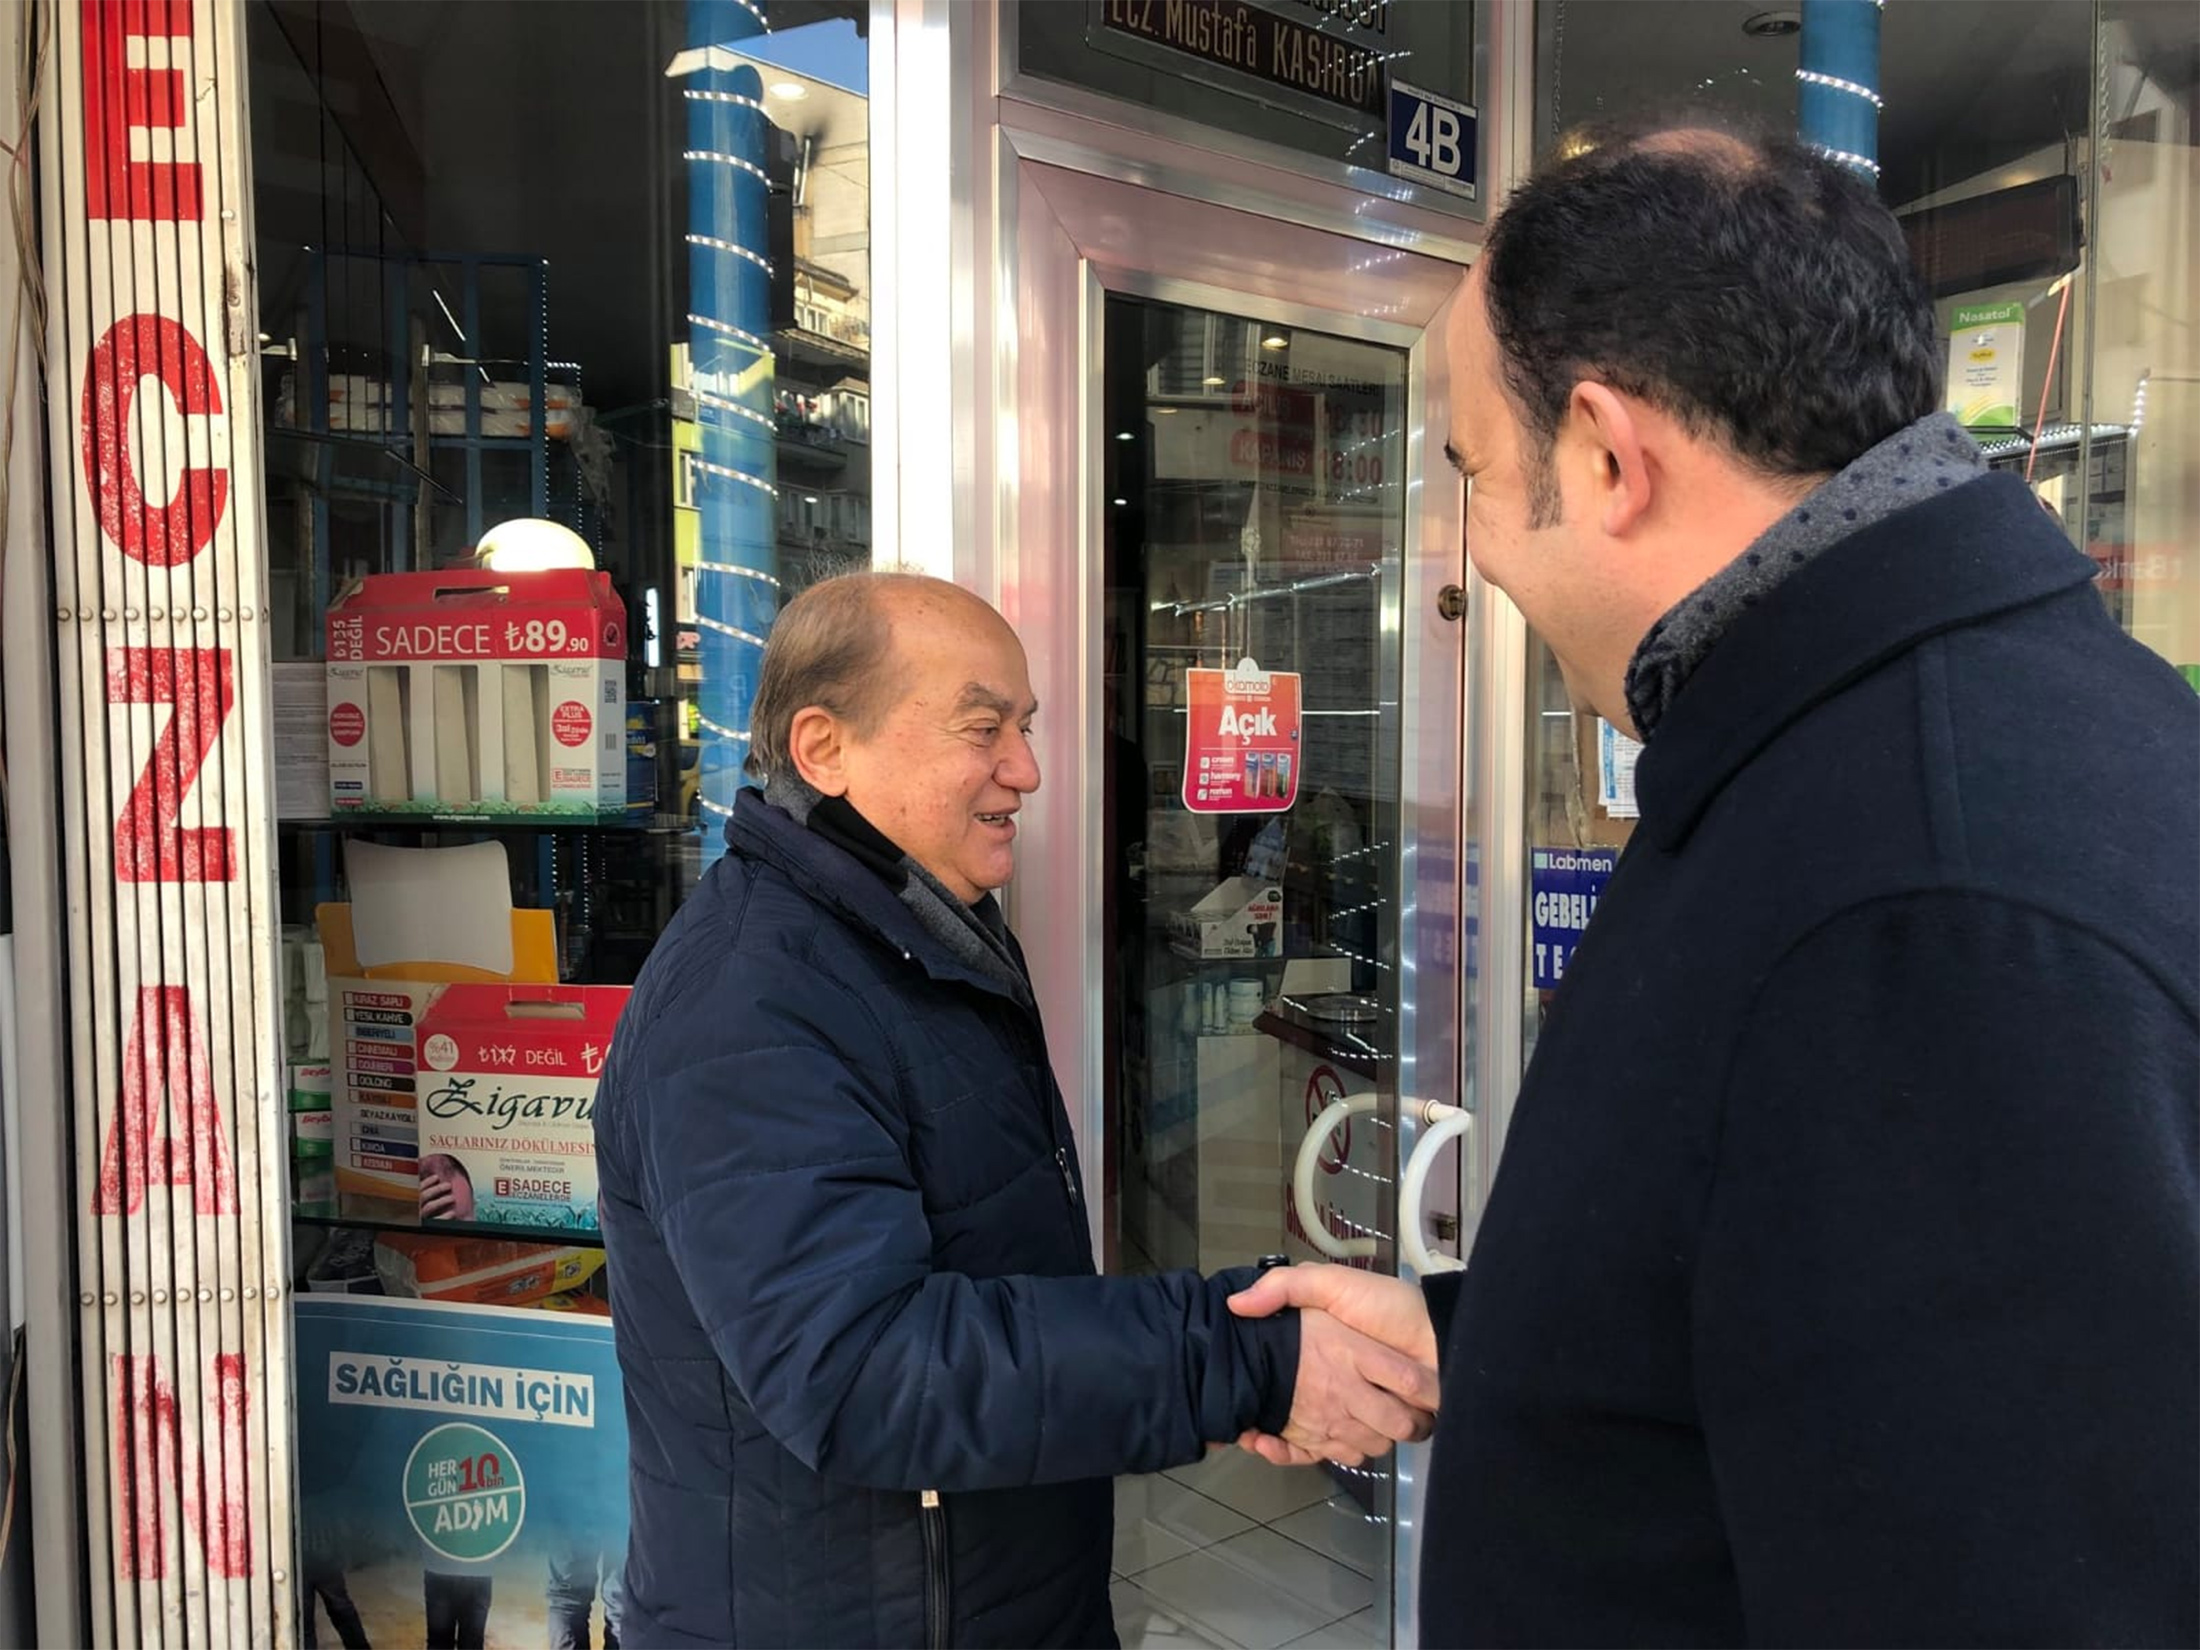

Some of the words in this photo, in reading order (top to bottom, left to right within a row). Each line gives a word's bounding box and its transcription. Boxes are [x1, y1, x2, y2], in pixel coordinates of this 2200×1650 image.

[1166, 0, 1257, 68] Mustafa
[1405, 101, 1461, 176] 4B
[376, 624, 491, 656] SADECE
[1218, 704, 1277, 745] Açık
[1549, 853, 1613, 873] Labmen
[526, 1048, 567, 1066] DEĞİL
[429, 1134, 508, 1150] SAÇLARINIZ
[512, 1178, 571, 1195] SADECE
[335, 1357, 503, 1408] SAĞLIĞIN
[516, 1371, 589, 1421] İÇİN
[428, 1458, 457, 1479] HER
[459, 1451, 499, 1492] 10
[428, 1477, 457, 1497] GÜN
